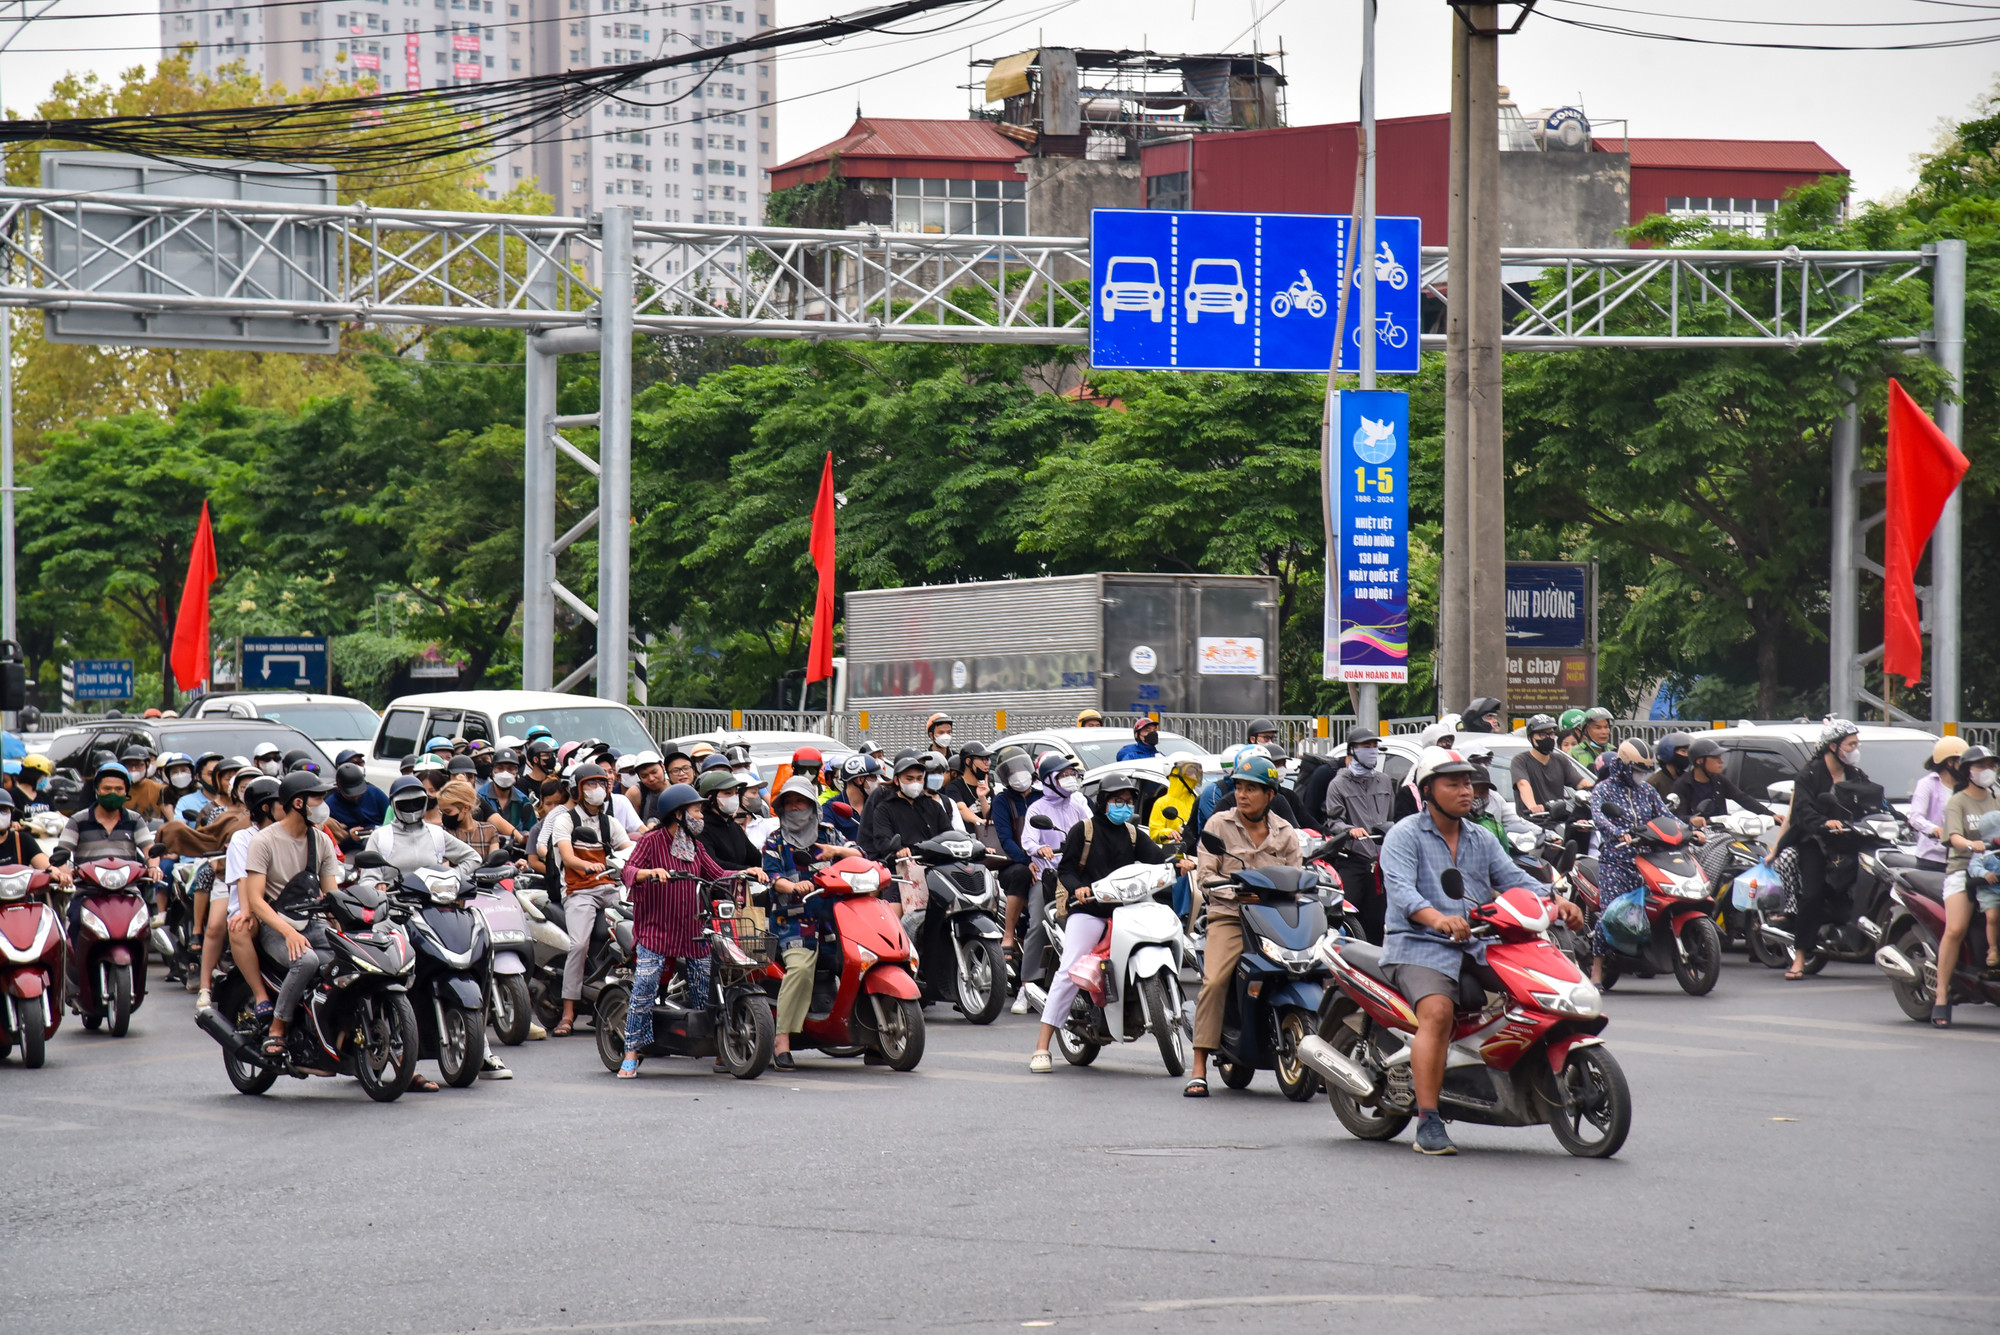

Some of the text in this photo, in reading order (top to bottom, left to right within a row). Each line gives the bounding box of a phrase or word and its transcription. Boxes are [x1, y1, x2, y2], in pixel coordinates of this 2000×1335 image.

[1354, 466, 1393, 494] 1-5
[1354, 495, 1372, 503] 1886
[1355, 515, 1393, 532] NHIỆT LIỆT
[1353, 532, 1395, 547] CHÀO MỪNG
[1358, 551, 1389, 565] 138 NĂM
[1348, 567, 1400, 583] NGÀY QUỐC TẾ
[1355, 587, 1368, 600] LAO
[1505, 581, 1575, 619] INH ĐƯỜNG
[1527, 657, 1560, 676] chay
[77, 672, 123, 686] BỆNH VIỆN K
[1344, 669, 1364, 680] QUẬN
[1365, 669, 1389, 680] HOÀNG
[1390, 671, 1405, 680] MAI
[1510, 1025, 1533, 1034] HONDA
